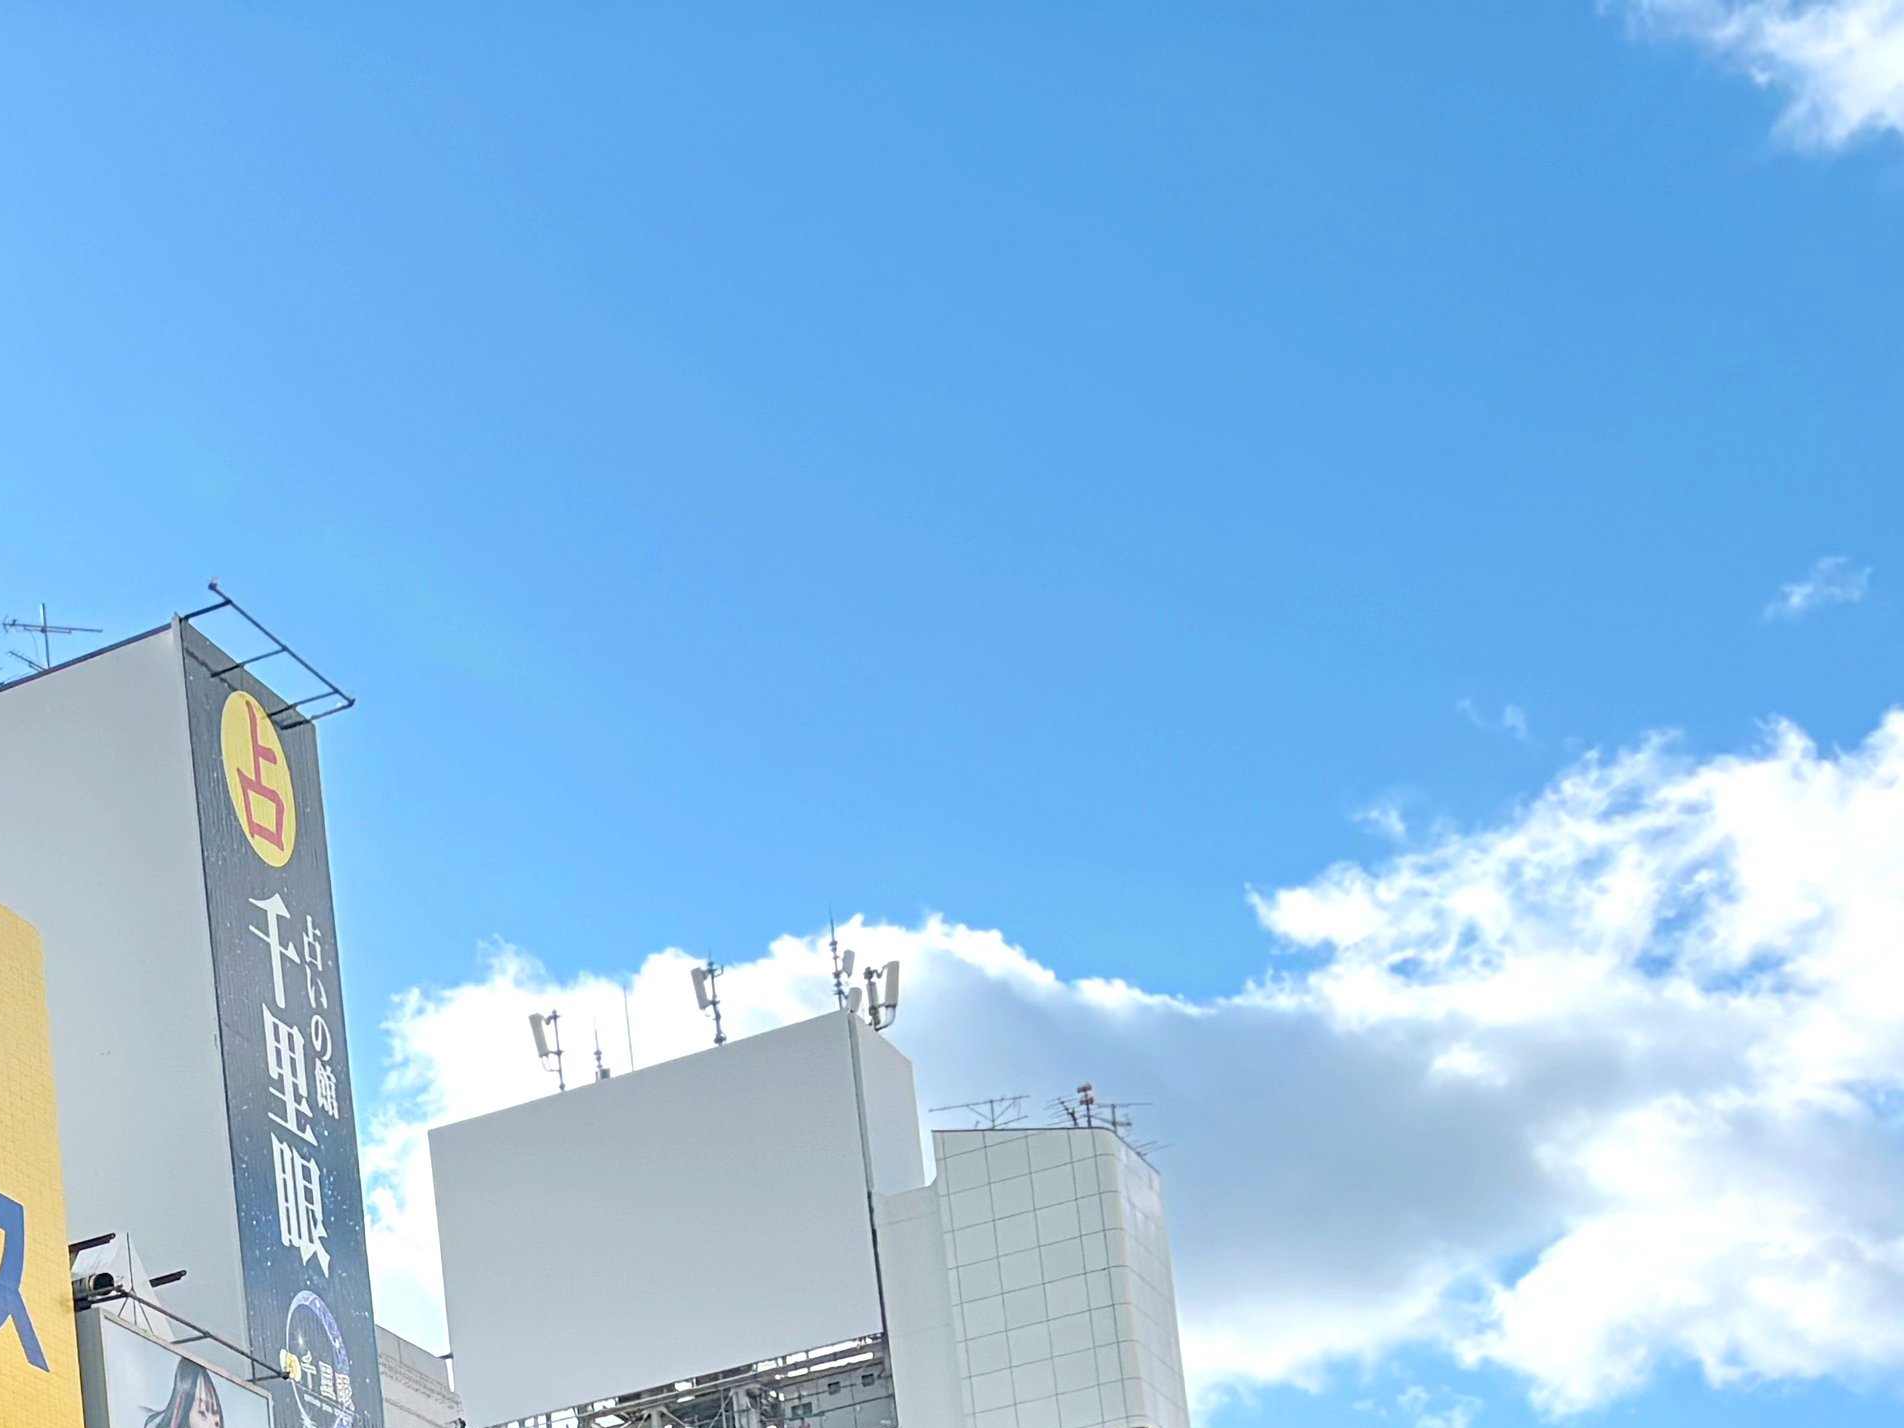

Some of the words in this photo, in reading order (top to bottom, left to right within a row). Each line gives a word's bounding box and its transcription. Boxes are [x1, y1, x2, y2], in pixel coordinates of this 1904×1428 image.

[248, 891, 330, 1278] 千里眼
[302, 913, 340, 1120] 占いの館
